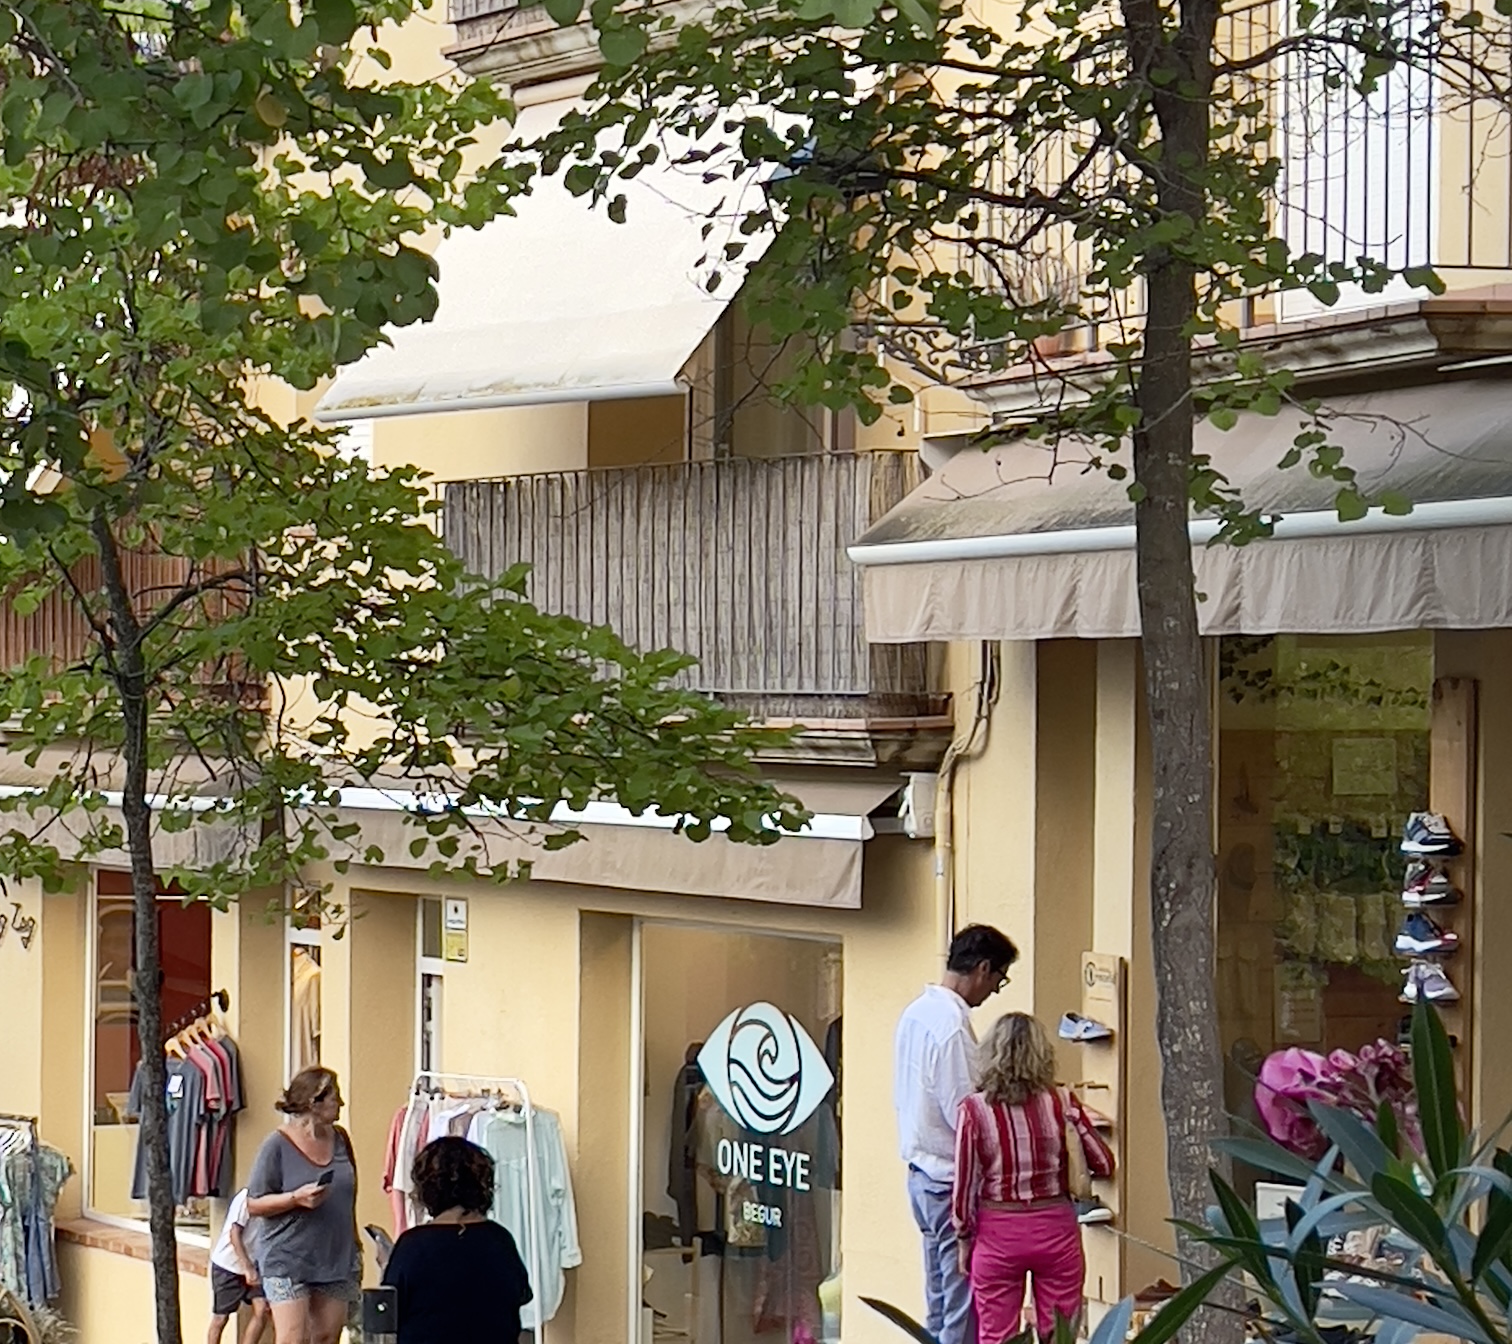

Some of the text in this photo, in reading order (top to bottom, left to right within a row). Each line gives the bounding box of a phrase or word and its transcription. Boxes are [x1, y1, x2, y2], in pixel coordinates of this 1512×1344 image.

[717, 1138, 810, 1191] ONE EYE
[742, 1201, 782, 1228] BEGUR
